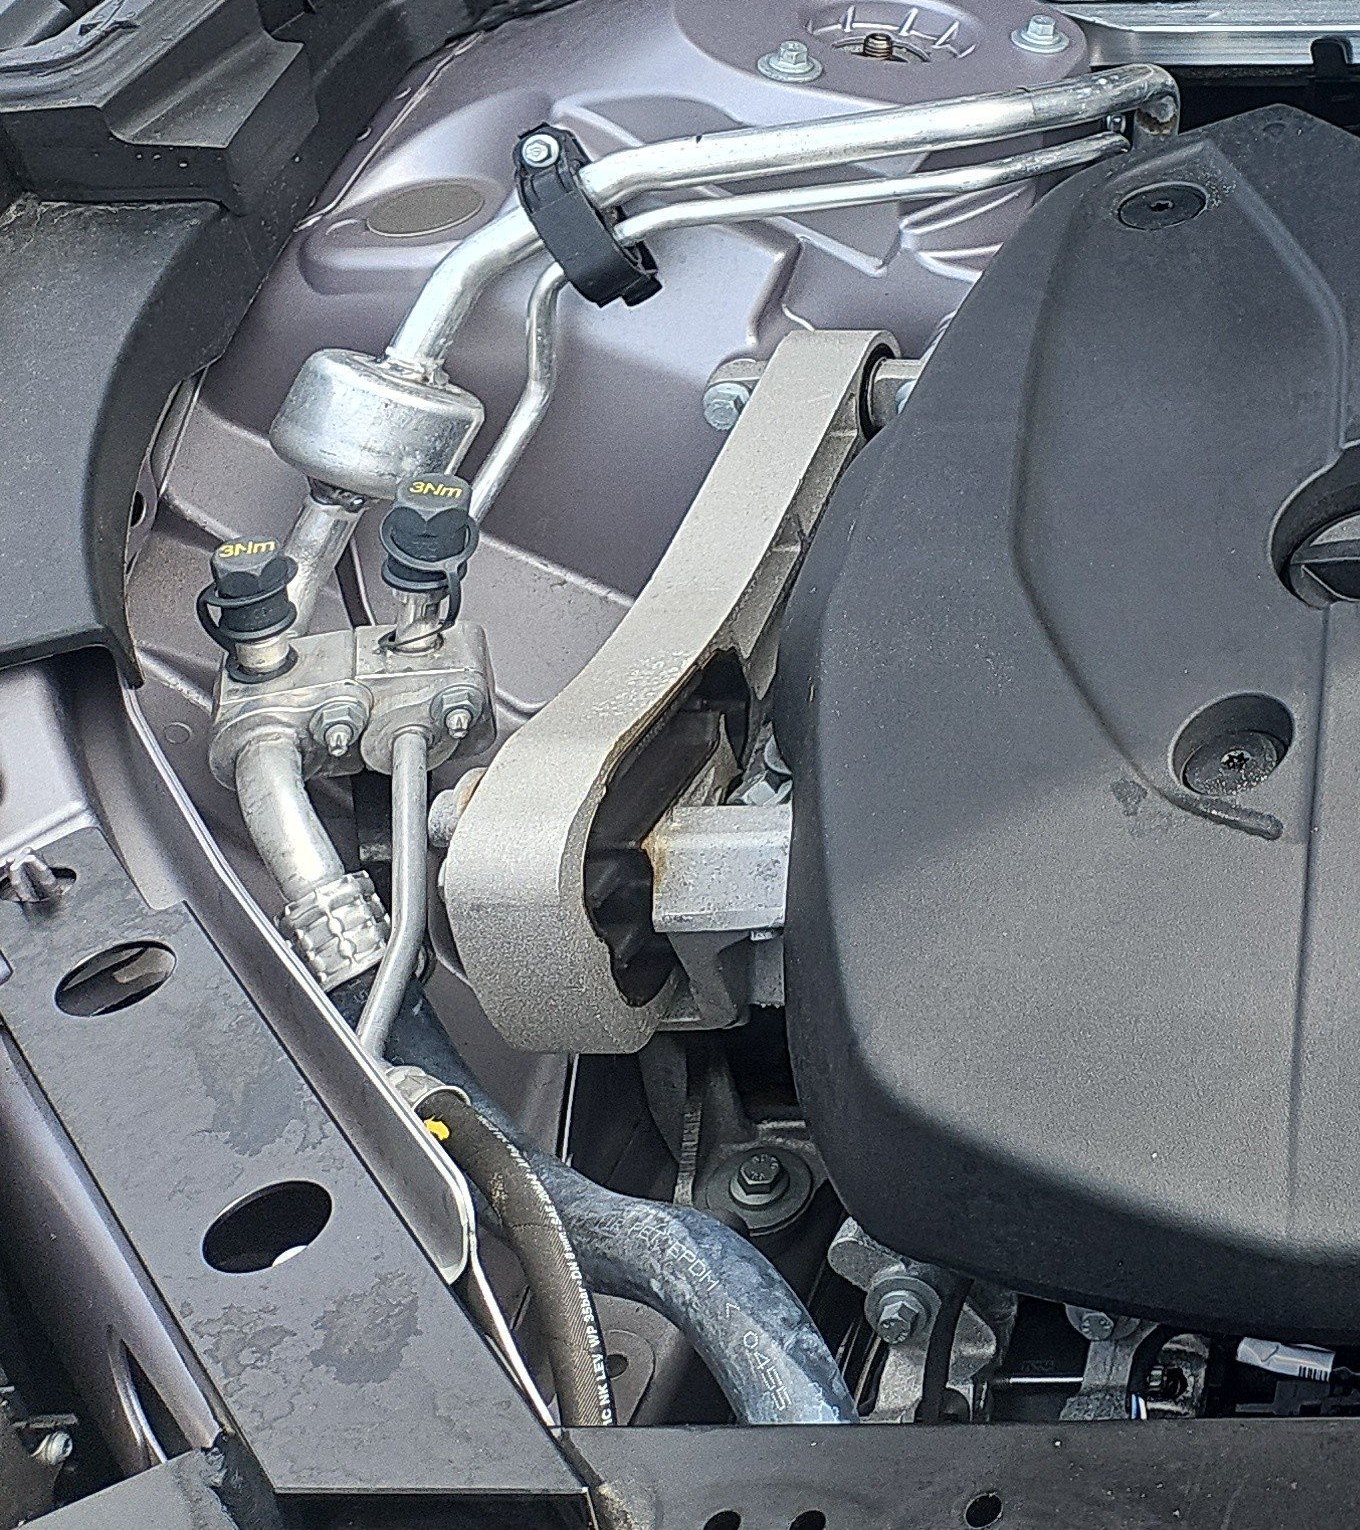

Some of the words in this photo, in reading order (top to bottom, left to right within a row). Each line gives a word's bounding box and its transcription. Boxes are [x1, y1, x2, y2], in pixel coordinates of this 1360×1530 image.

[410, 480, 463, 499] 3Nm
[218, 539, 276, 558] 3Nm
[669, 1240, 720, 1293] EPDM
[587, 1327, 602, 1349] WP
[743, 1331, 793, 1412] 0455
